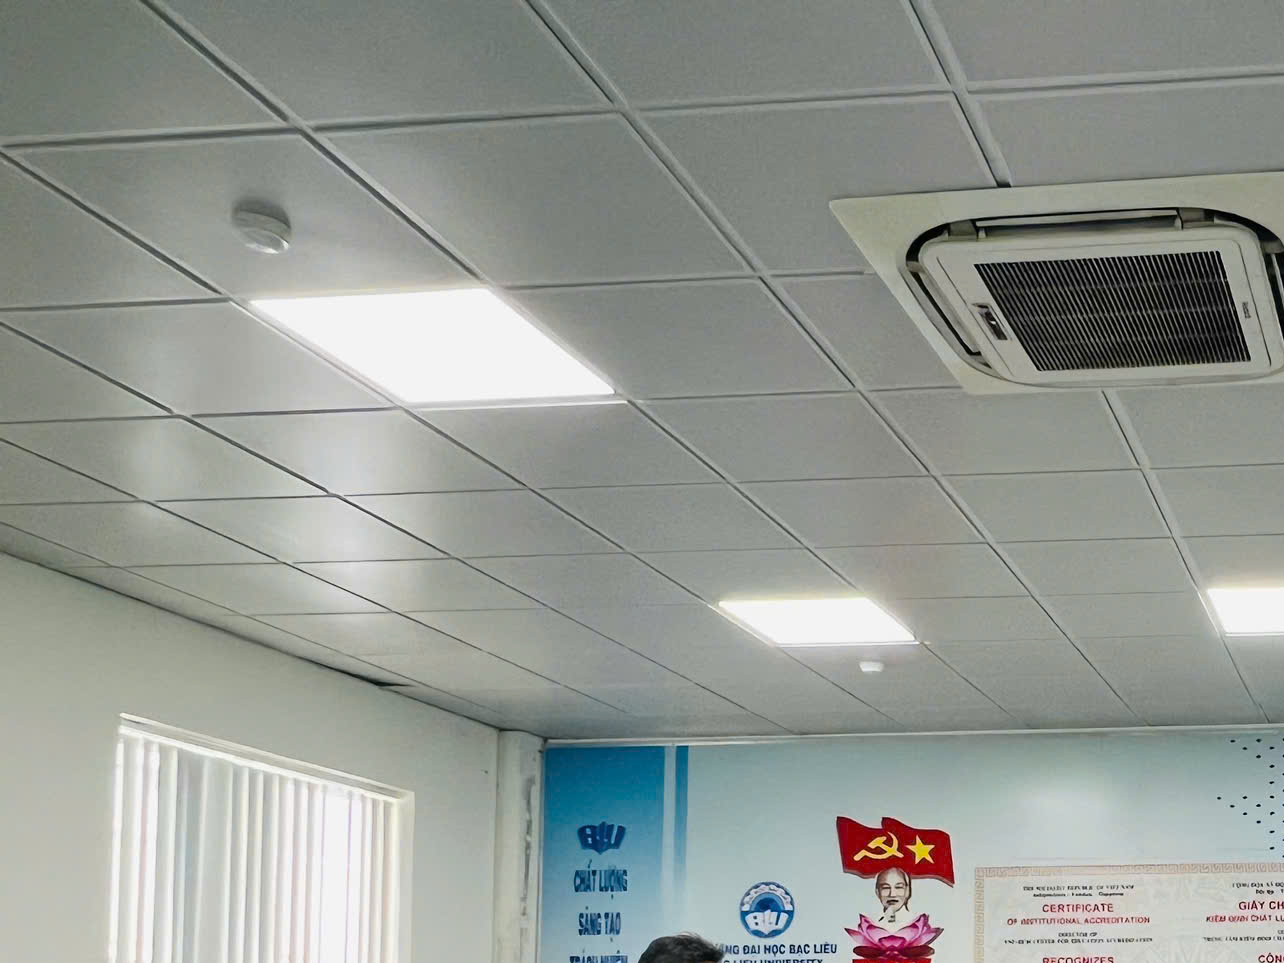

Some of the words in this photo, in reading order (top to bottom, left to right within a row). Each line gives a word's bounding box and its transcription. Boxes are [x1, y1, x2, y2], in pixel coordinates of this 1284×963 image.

[573, 859, 597, 893] CHẤT
[1042, 903, 1114, 913] CERTIFICATE
[578, 906, 601, 936] SÁNG
[604, 912, 621, 942] TẠO
[763, 943, 786, 957] HỌC
[789, 944, 811, 956] BẠC
[813, 942, 838, 954] LIÊU
